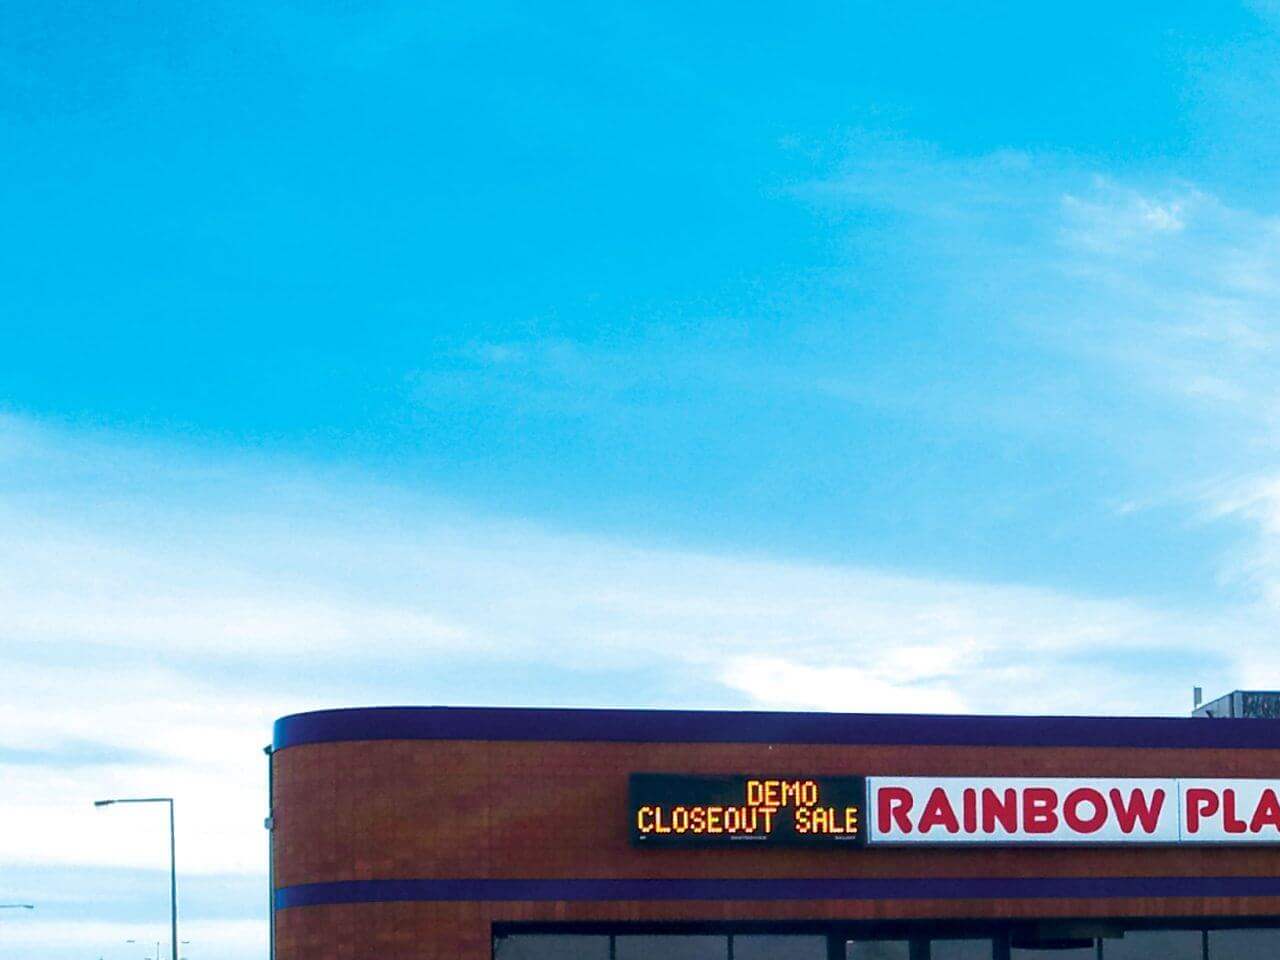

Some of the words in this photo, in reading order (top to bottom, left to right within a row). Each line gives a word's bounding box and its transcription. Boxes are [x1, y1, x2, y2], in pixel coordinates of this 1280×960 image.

[747, 780, 818, 807] DEMO
[637, 806, 777, 833] CLOSEOUT
[795, 807, 858, 833] SALE
[877, 786, 1166, 835] RAINBOW
